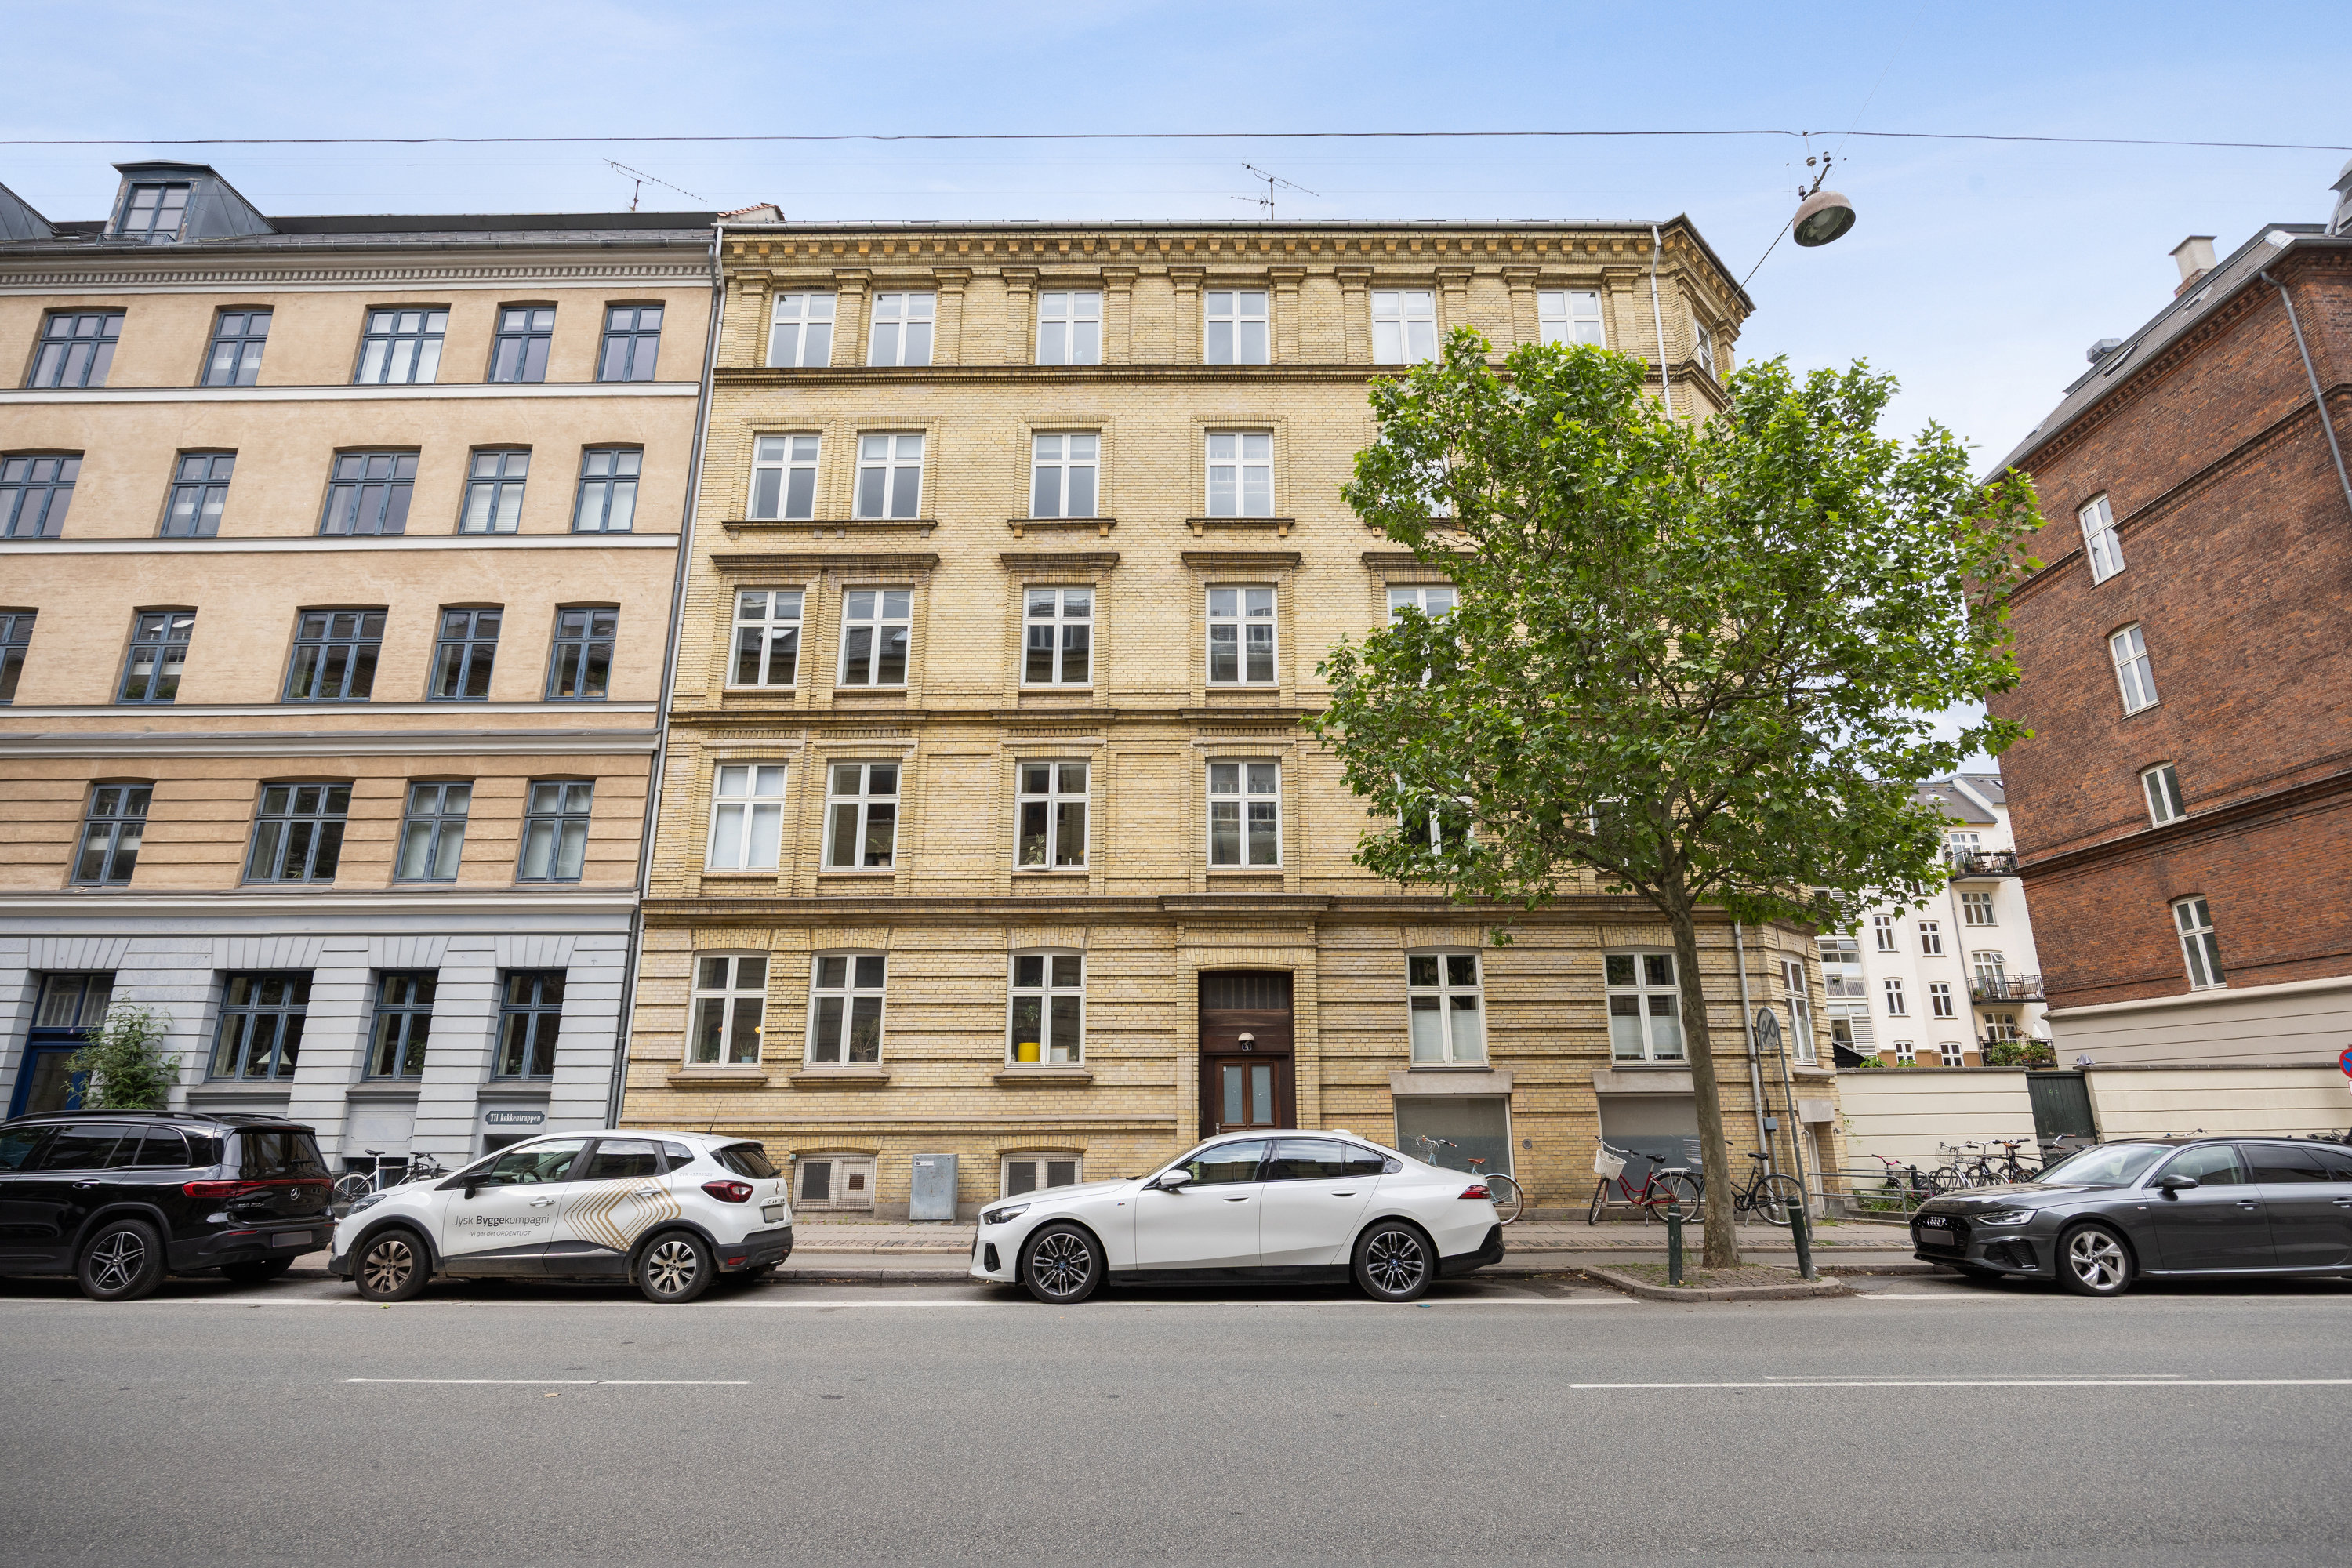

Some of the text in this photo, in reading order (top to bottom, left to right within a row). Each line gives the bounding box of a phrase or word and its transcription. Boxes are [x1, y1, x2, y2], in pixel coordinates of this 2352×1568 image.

[490, 1113, 541, 1123] Til køkkentrappen
[455, 1214, 550, 1227] Jysk Byggekompagni
